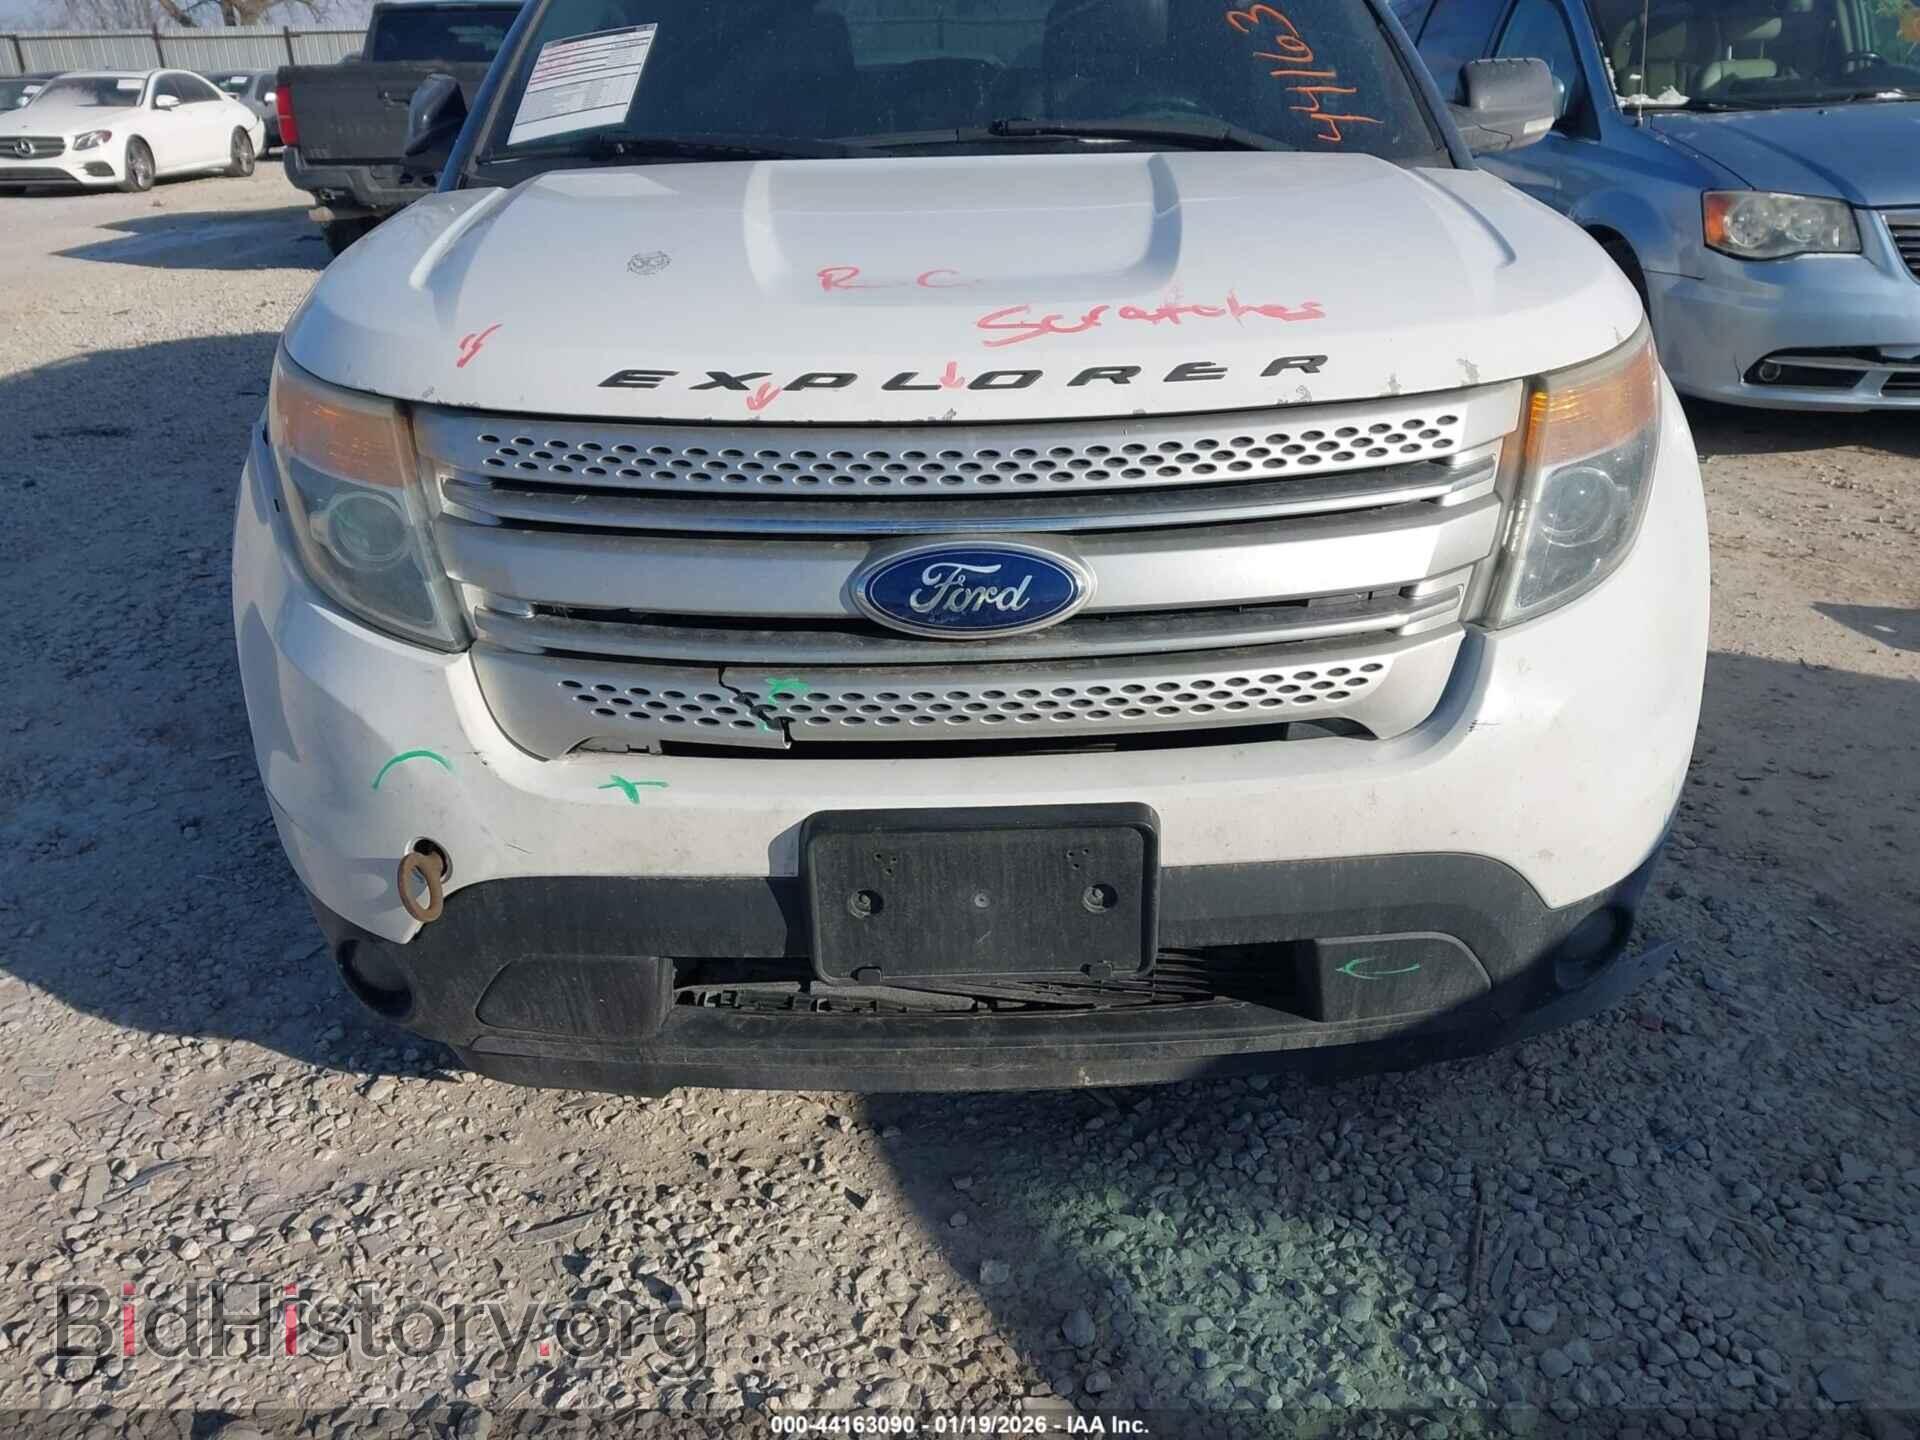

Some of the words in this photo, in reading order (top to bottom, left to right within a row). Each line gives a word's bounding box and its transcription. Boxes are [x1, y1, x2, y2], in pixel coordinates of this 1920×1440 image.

[1226, 4, 1384, 142] 44163
[598, 353, 1329, 391] EXPLORER
[909, 561, 1033, 614] Ford
